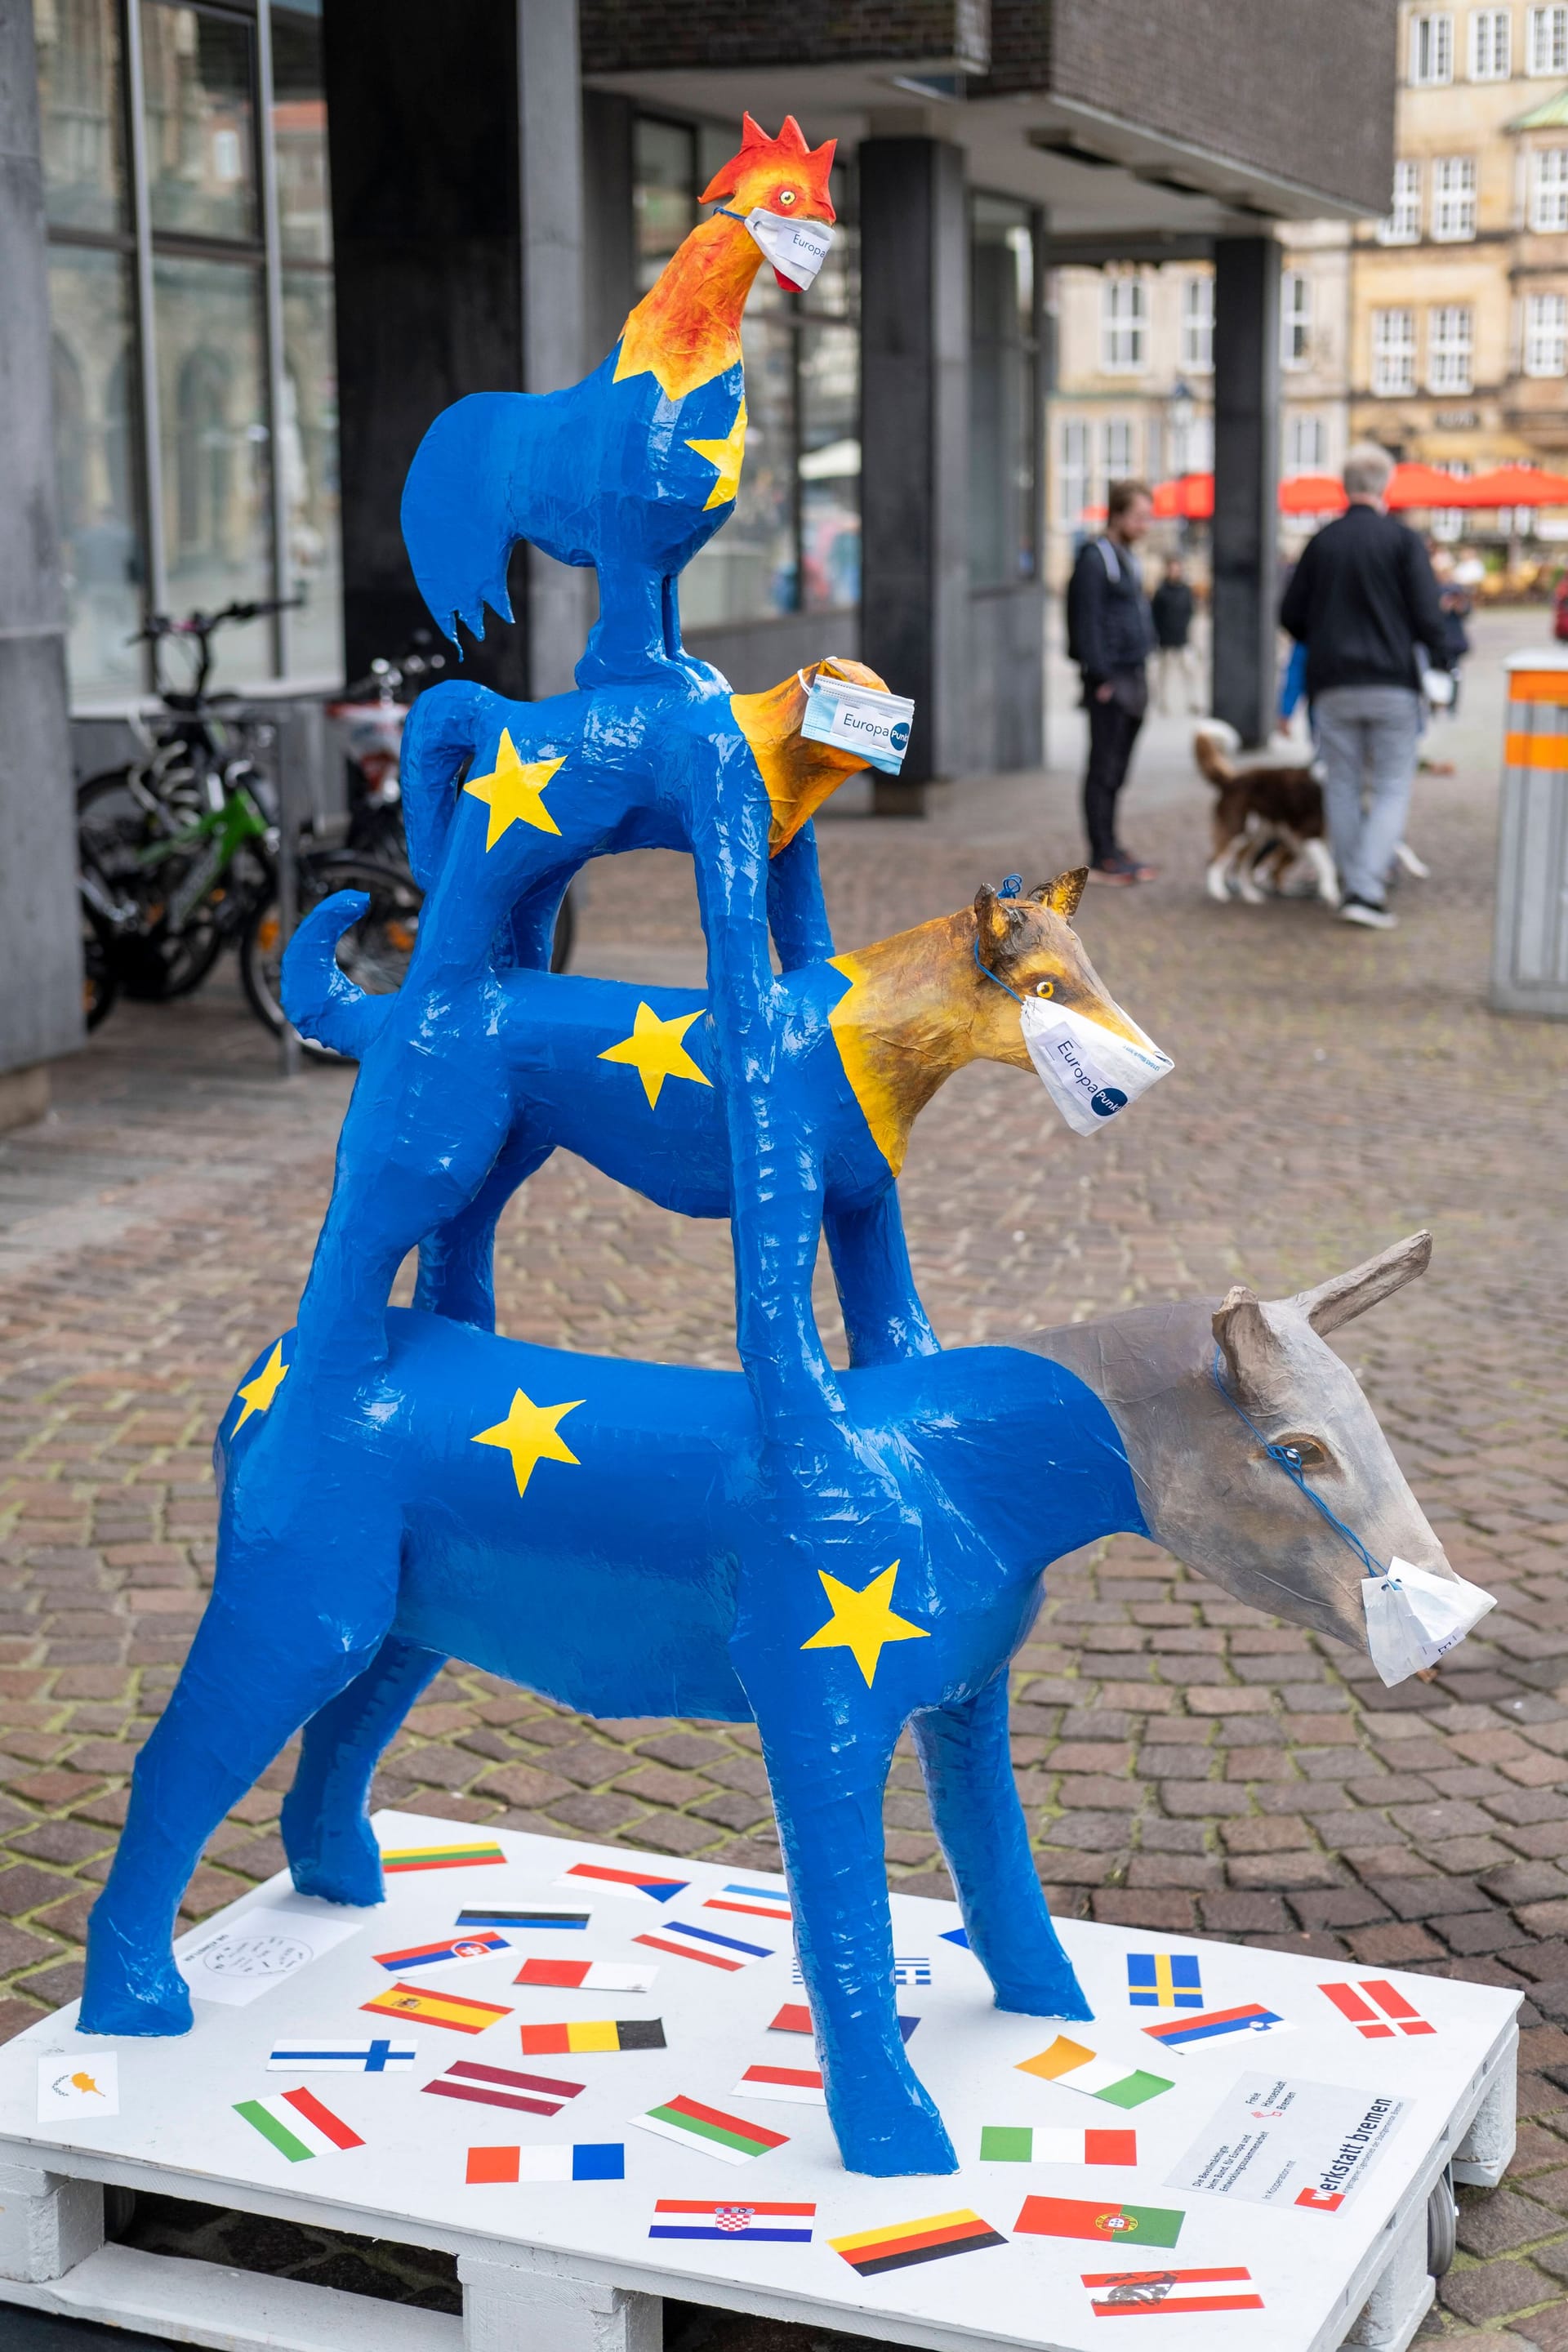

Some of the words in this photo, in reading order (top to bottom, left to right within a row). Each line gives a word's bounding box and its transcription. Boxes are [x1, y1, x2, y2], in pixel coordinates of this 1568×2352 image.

[793, 234, 826, 258] Europa
[844, 713, 889, 737] Europa
[1058, 1040, 1098, 1094] Europa
[1245, 2092, 1261, 2105] Freie
[1261, 2081, 1287, 2107] Hansestadt
[1276, 2091, 1296, 2110] Bremen
[1198, 2145, 1228, 2178] Bevollmächtigte
[1205, 2178, 1220, 2189] beim
[1228, 2144, 1245, 2158] Europa
[1241, 2134, 1251, 2143] und
[1218, 2132, 1269, 2191] Entwicklungszusammenarbeit
[1312, 2144, 1364, 2201] werkstatt
[1345, 2098, 1392, 2142] bremen
[1192, 2179, 1205, 2187] Die
[1265, 2167, 1290, 2194] Kooperation
